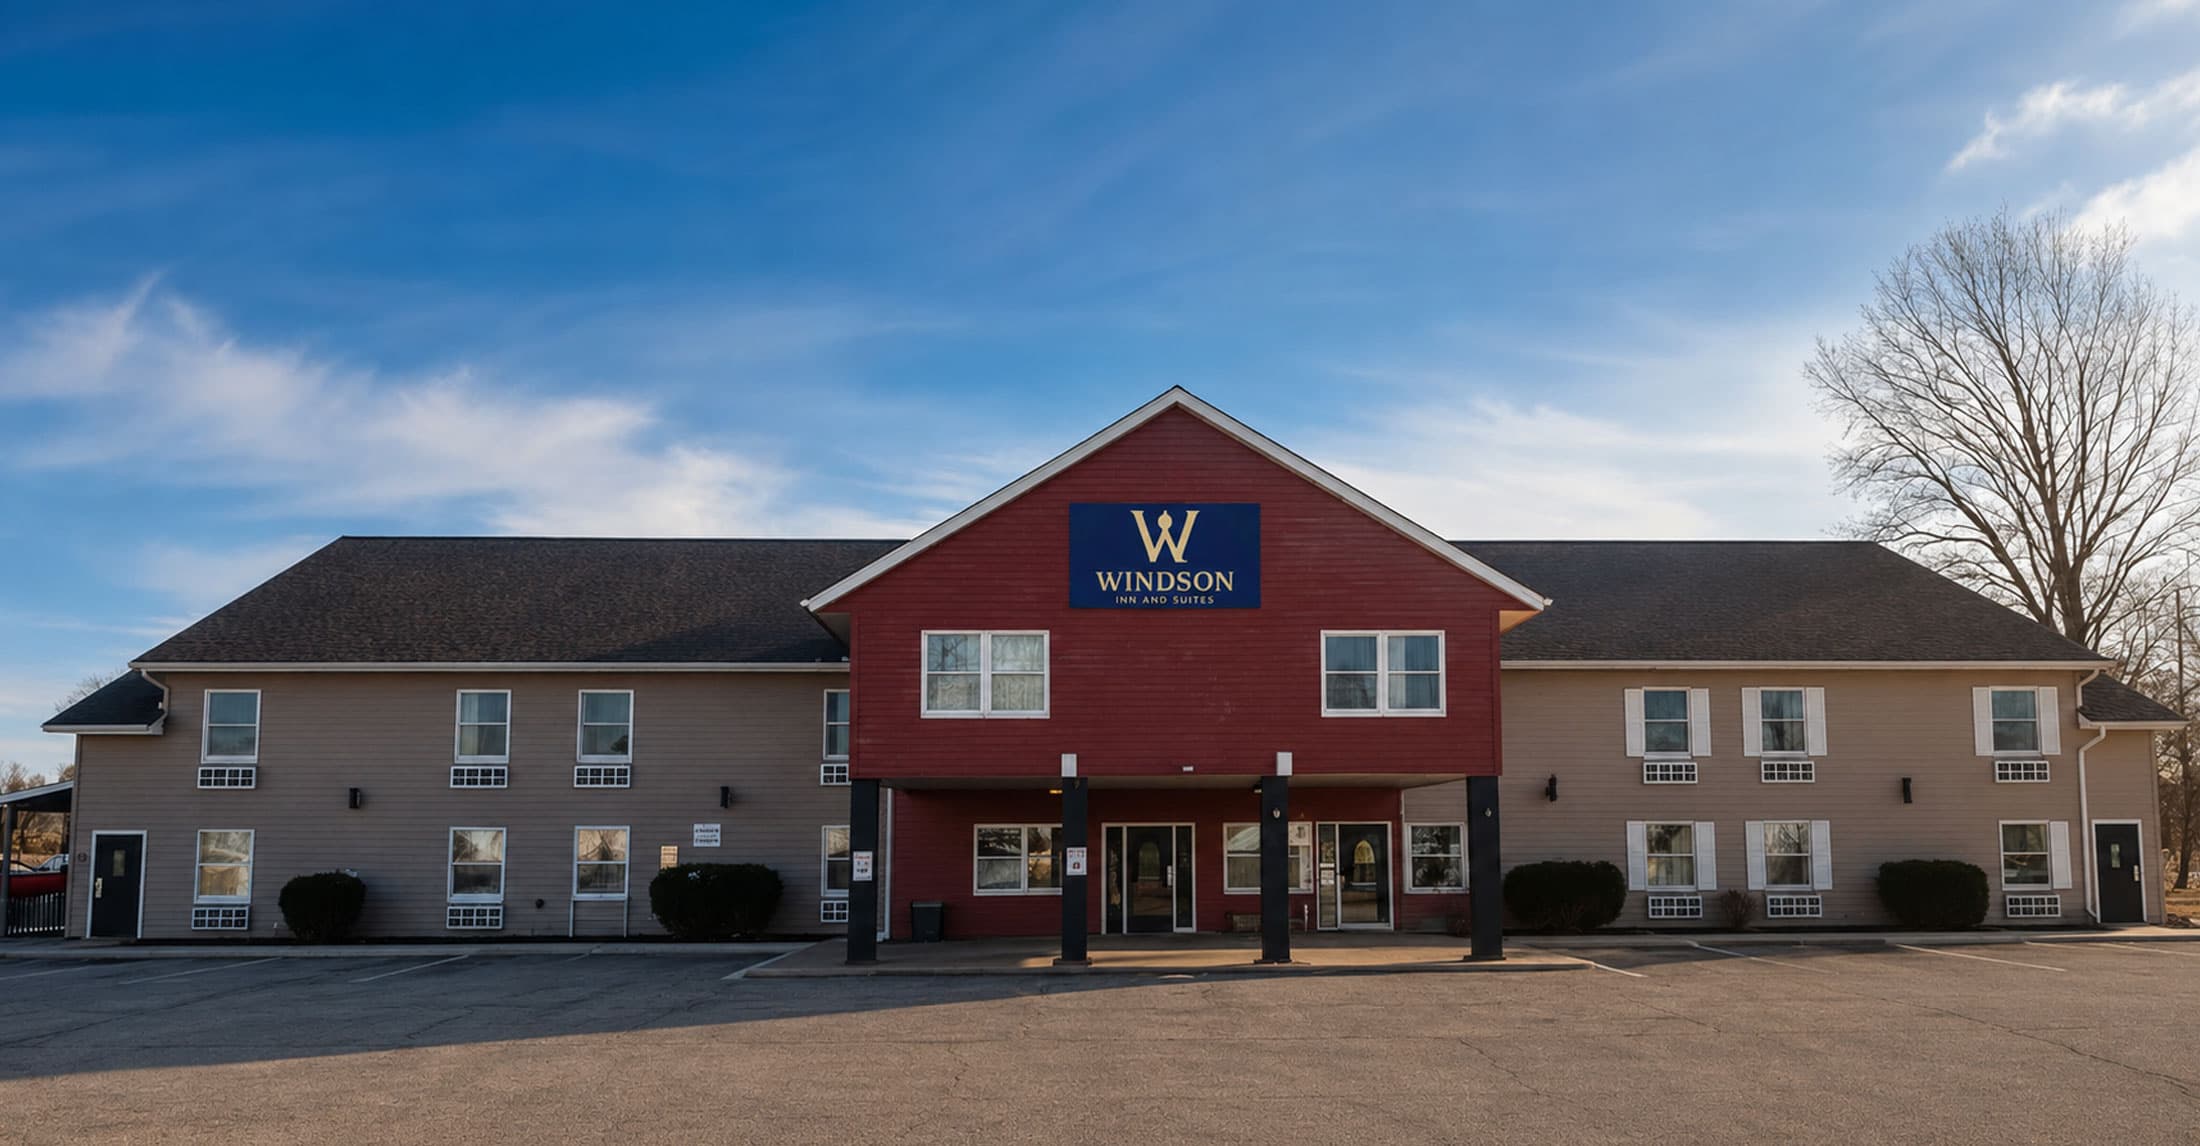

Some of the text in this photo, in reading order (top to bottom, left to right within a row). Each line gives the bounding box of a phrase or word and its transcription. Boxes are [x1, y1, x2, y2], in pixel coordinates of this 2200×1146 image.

[1096, 571, 1234, 592] WINDSON
[1116, 596, 1214, 604] INN AND SUITES
